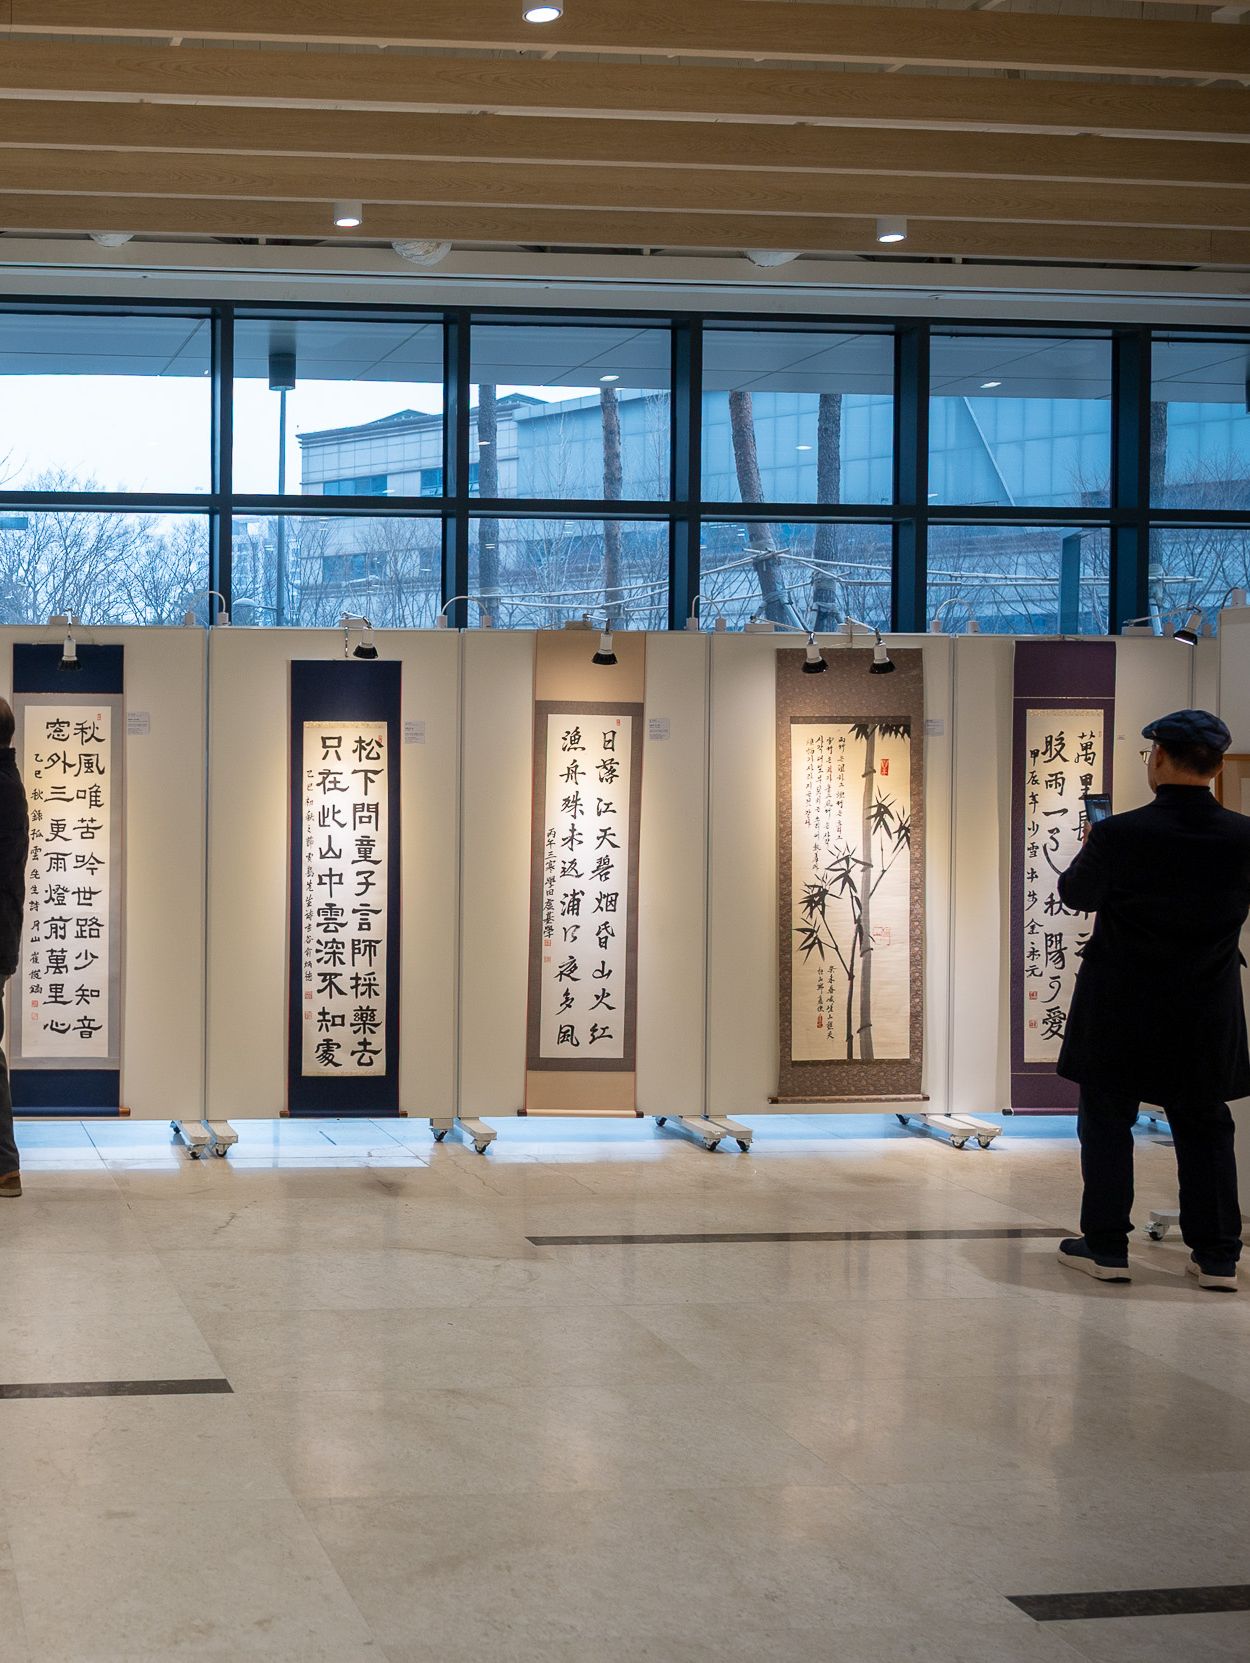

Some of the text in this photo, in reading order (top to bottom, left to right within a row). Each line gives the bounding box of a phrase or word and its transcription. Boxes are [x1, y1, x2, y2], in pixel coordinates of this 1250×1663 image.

[71, 720, 106, 1039] 秋風唯苦吟世路少知音
